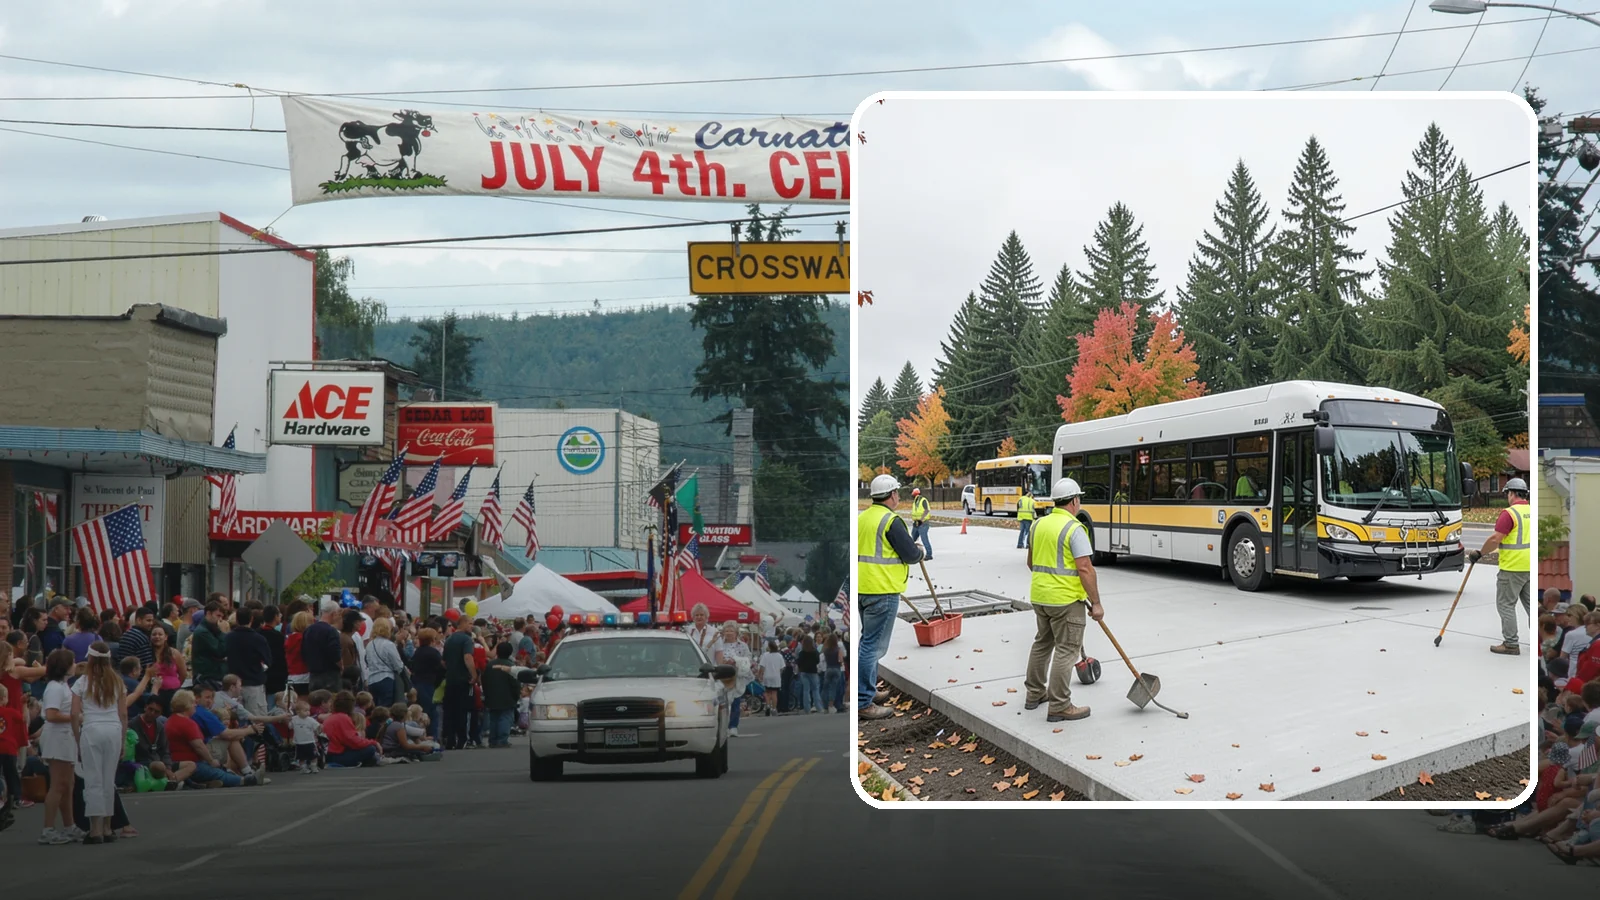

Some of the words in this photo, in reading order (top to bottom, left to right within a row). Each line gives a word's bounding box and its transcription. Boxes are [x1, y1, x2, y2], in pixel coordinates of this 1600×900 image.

[481, 141, 604, 193] JULY
[632, 150, 746, 198] 4th.
[697, 254, 850, 280] CROSSWA
[282, 380, 373, 420] ACE
[405, 409, 453, 422] CEDAR
[283, 421, 371, 437] Hardware
[416, 428, 477, 447] Coca-Cola
[83, 485, 93, 494] St.
[96, 485, 124, 495] Vincent
[126, 486, 136, 495] de
[137, 486, 155, 495] Paul
[81, 503, 153, 522] THT
[688, 526, 741, 535] CRNATION
[699, 535, 730, 543] GLASS
